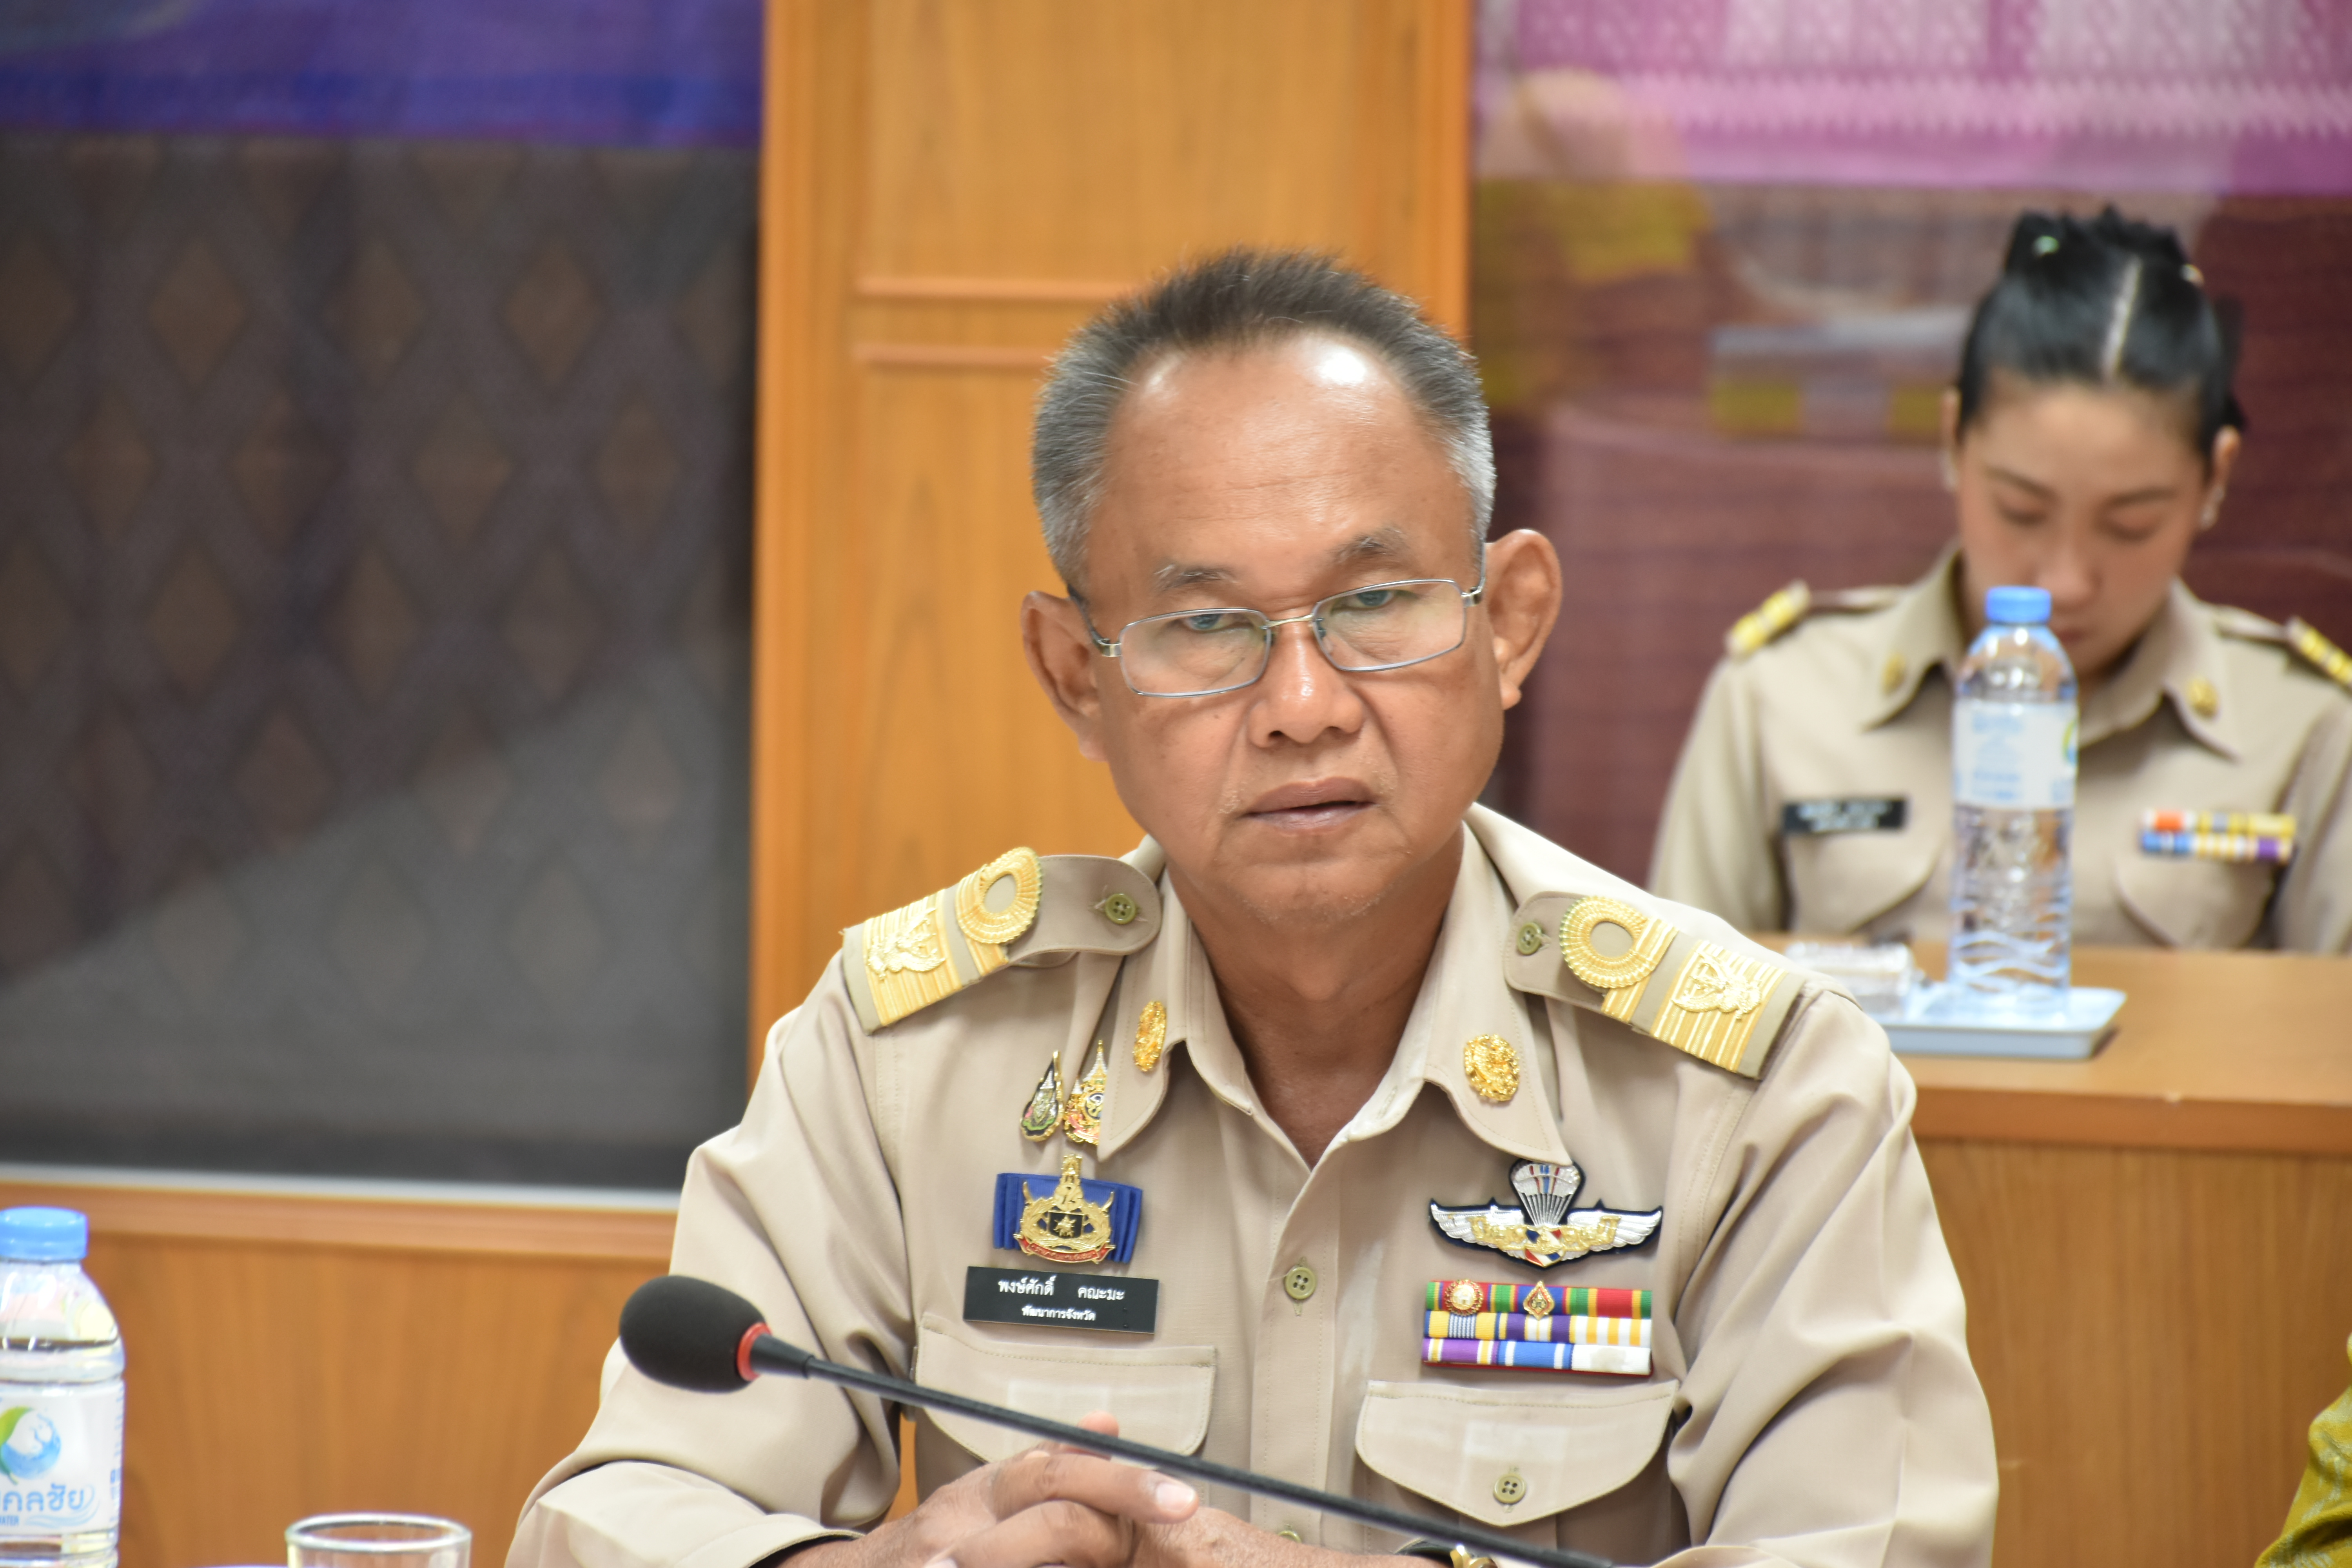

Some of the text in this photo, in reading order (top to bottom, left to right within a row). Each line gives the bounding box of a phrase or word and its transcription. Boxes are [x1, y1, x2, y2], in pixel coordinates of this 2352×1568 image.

[998, 1274, 1057, 1296] พงษ์ศักดิ์
[1022, 1305, 1096, 1321] พัฒนาการจังหวัด
[0, 1483, 84, 1512] คลชัย
